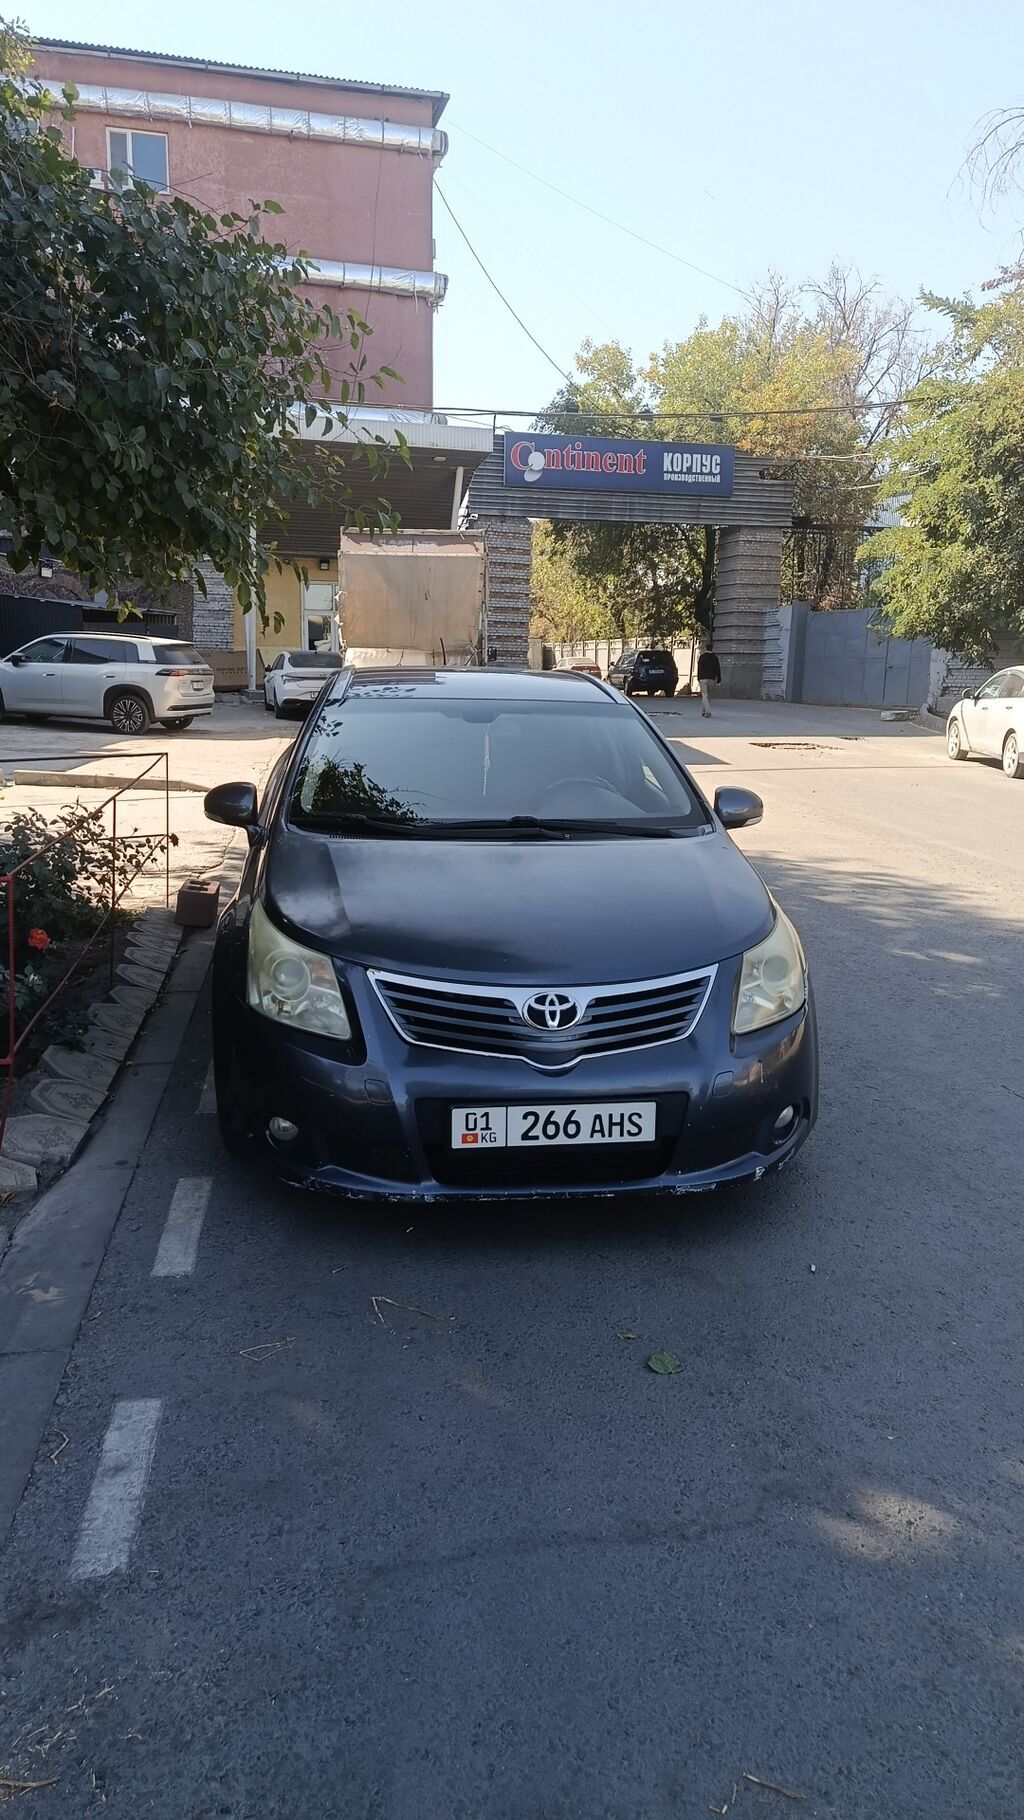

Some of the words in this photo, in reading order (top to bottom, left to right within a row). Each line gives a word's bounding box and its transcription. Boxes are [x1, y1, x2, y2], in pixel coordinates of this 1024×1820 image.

[510, 441, 647, 475] Continent
[663, 452, 721, 474] КОРПУС
[663, 473, 721, 483] ПРОИЗВОДСТВЕННЫЙ
[464, 1111, 493, 1132] 01
[520, 1109, 582, 1141] 266
[589, 1112, 644, 1139] AHS
[480, 1132, 497, 1143] KG
